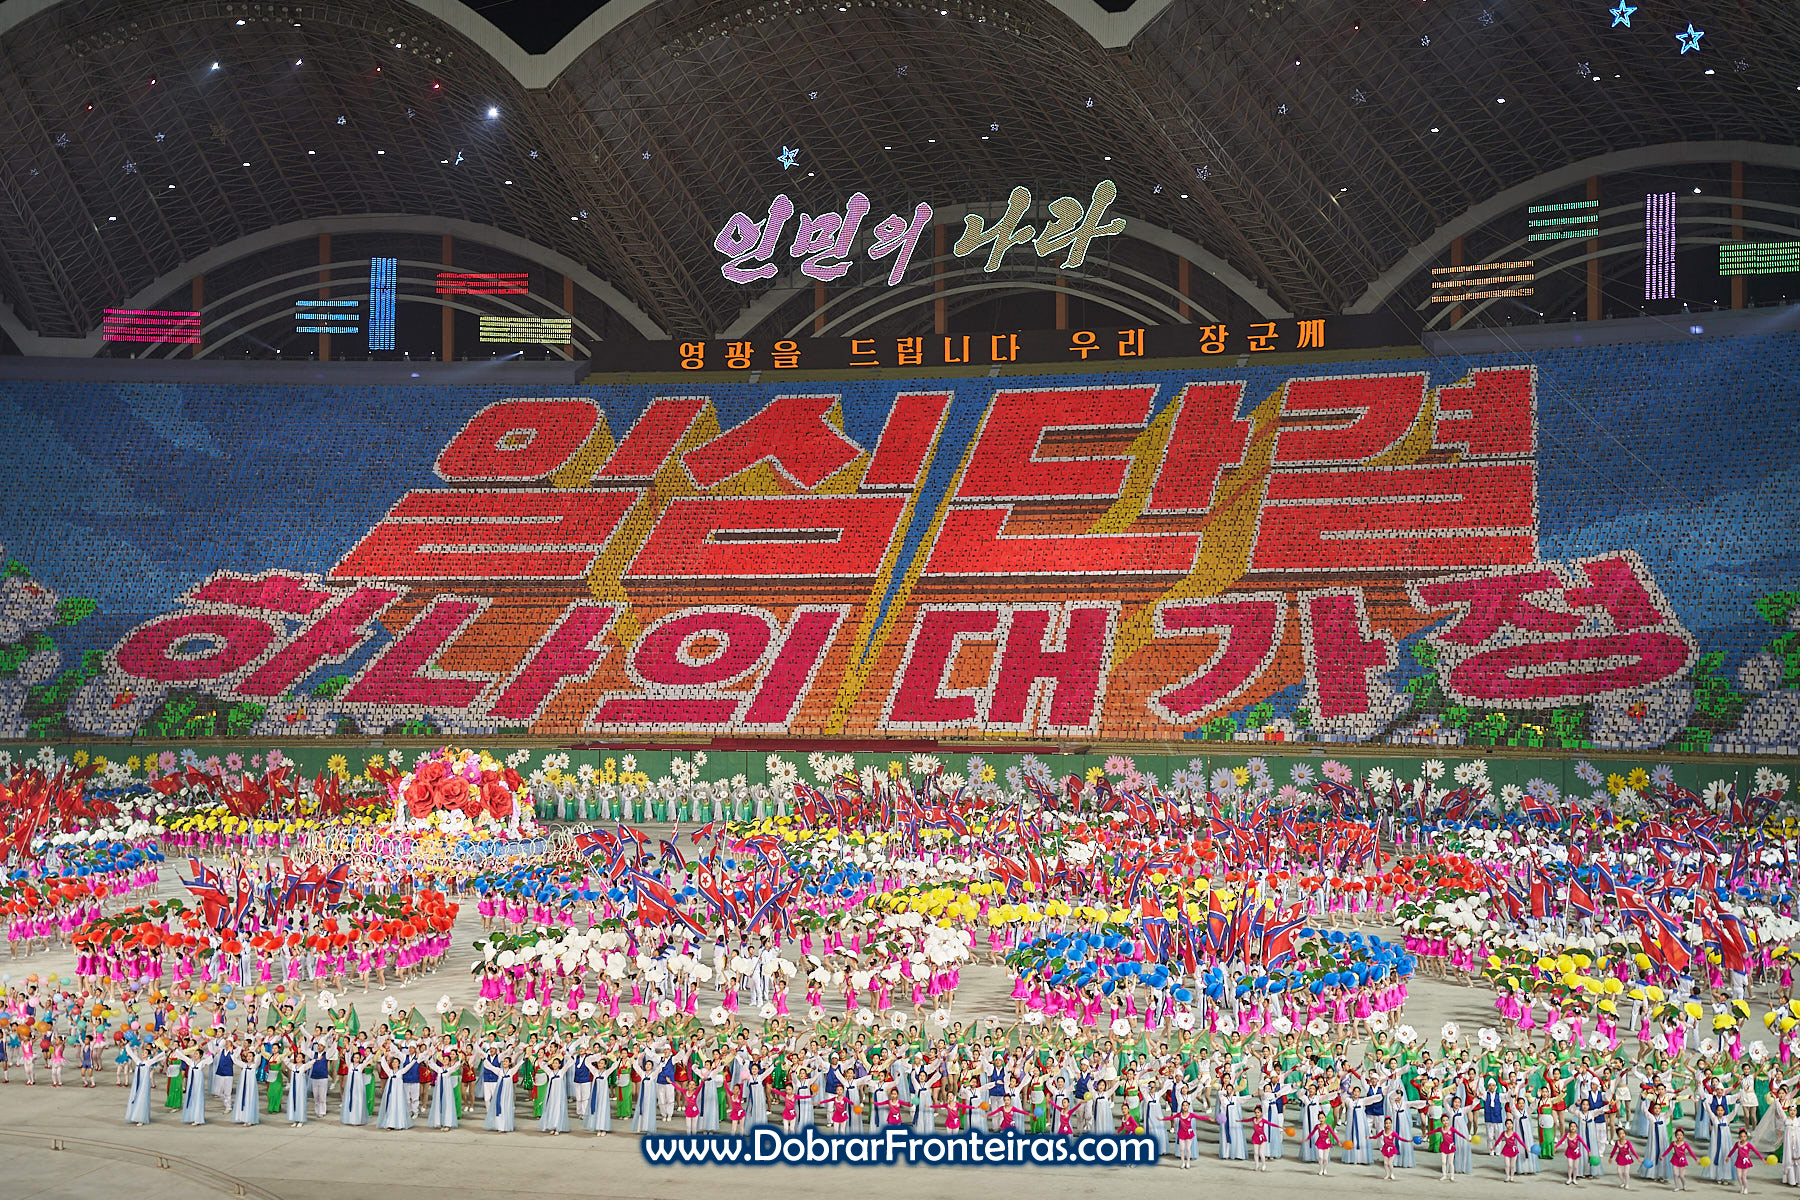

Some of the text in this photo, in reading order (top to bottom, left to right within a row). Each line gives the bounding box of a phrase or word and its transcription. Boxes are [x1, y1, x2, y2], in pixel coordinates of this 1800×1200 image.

[713, 179, 1128, 287] 인민의 나라
[679, 318, 1326, 370] 영광을 드립니다 우리 장군께
[326, 364, 1538, 580] 일심단결
[103, 549, 1700, 740] 하나의 대가정
